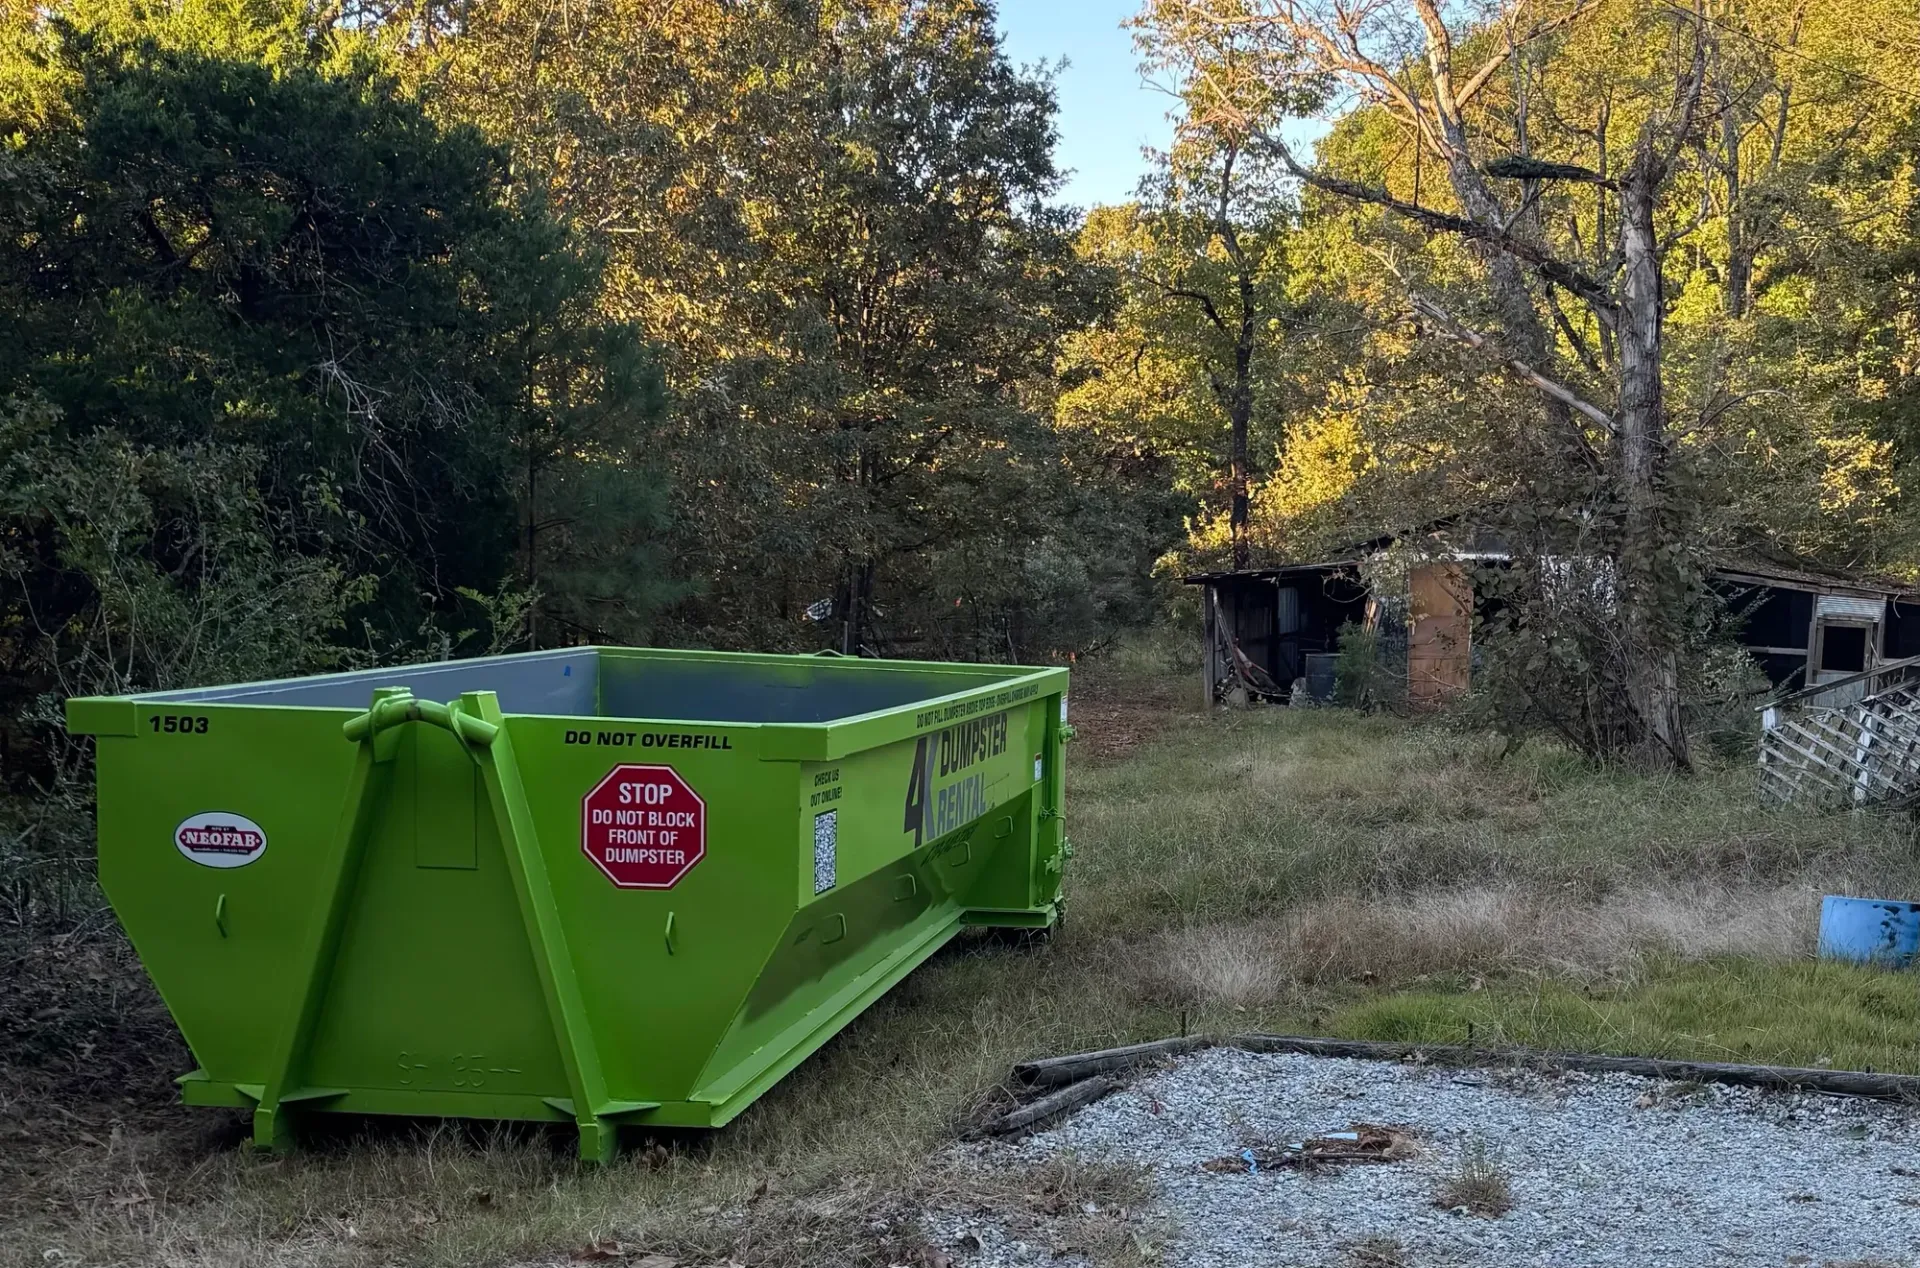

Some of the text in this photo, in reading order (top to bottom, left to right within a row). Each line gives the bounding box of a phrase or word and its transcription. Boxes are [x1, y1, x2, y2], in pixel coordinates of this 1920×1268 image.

[917, 714, 924, 729] DO
[925, 711, 933, 727] NOT
[934, 709, 943, 724] FILL
[944, 703, 965, 721] DUMPSTER
[966, 700, 978, 716] ABOVE
[149, 716, 209, 734] 1503
[565, 731, 733, 750] DO NOT OVERFILL
[940, 712, 1008, 778] DUMPSTER
[814, 768, 840, 787] CHECK US
[618, 782, 672, 805] STOP
[810, 786, 843, 807] OUT ONLINE!
[903, 732, 941, 849] 4K
[937, 772, 986, 837] RENTAL
[592, 809, 695, 827] DO NOT BLOCK
[185, 831, 256, 847] NEOFAB
[608, 829, 679, 846] FRONT OF
[605, 848, 685, 865] DUMPSTER
